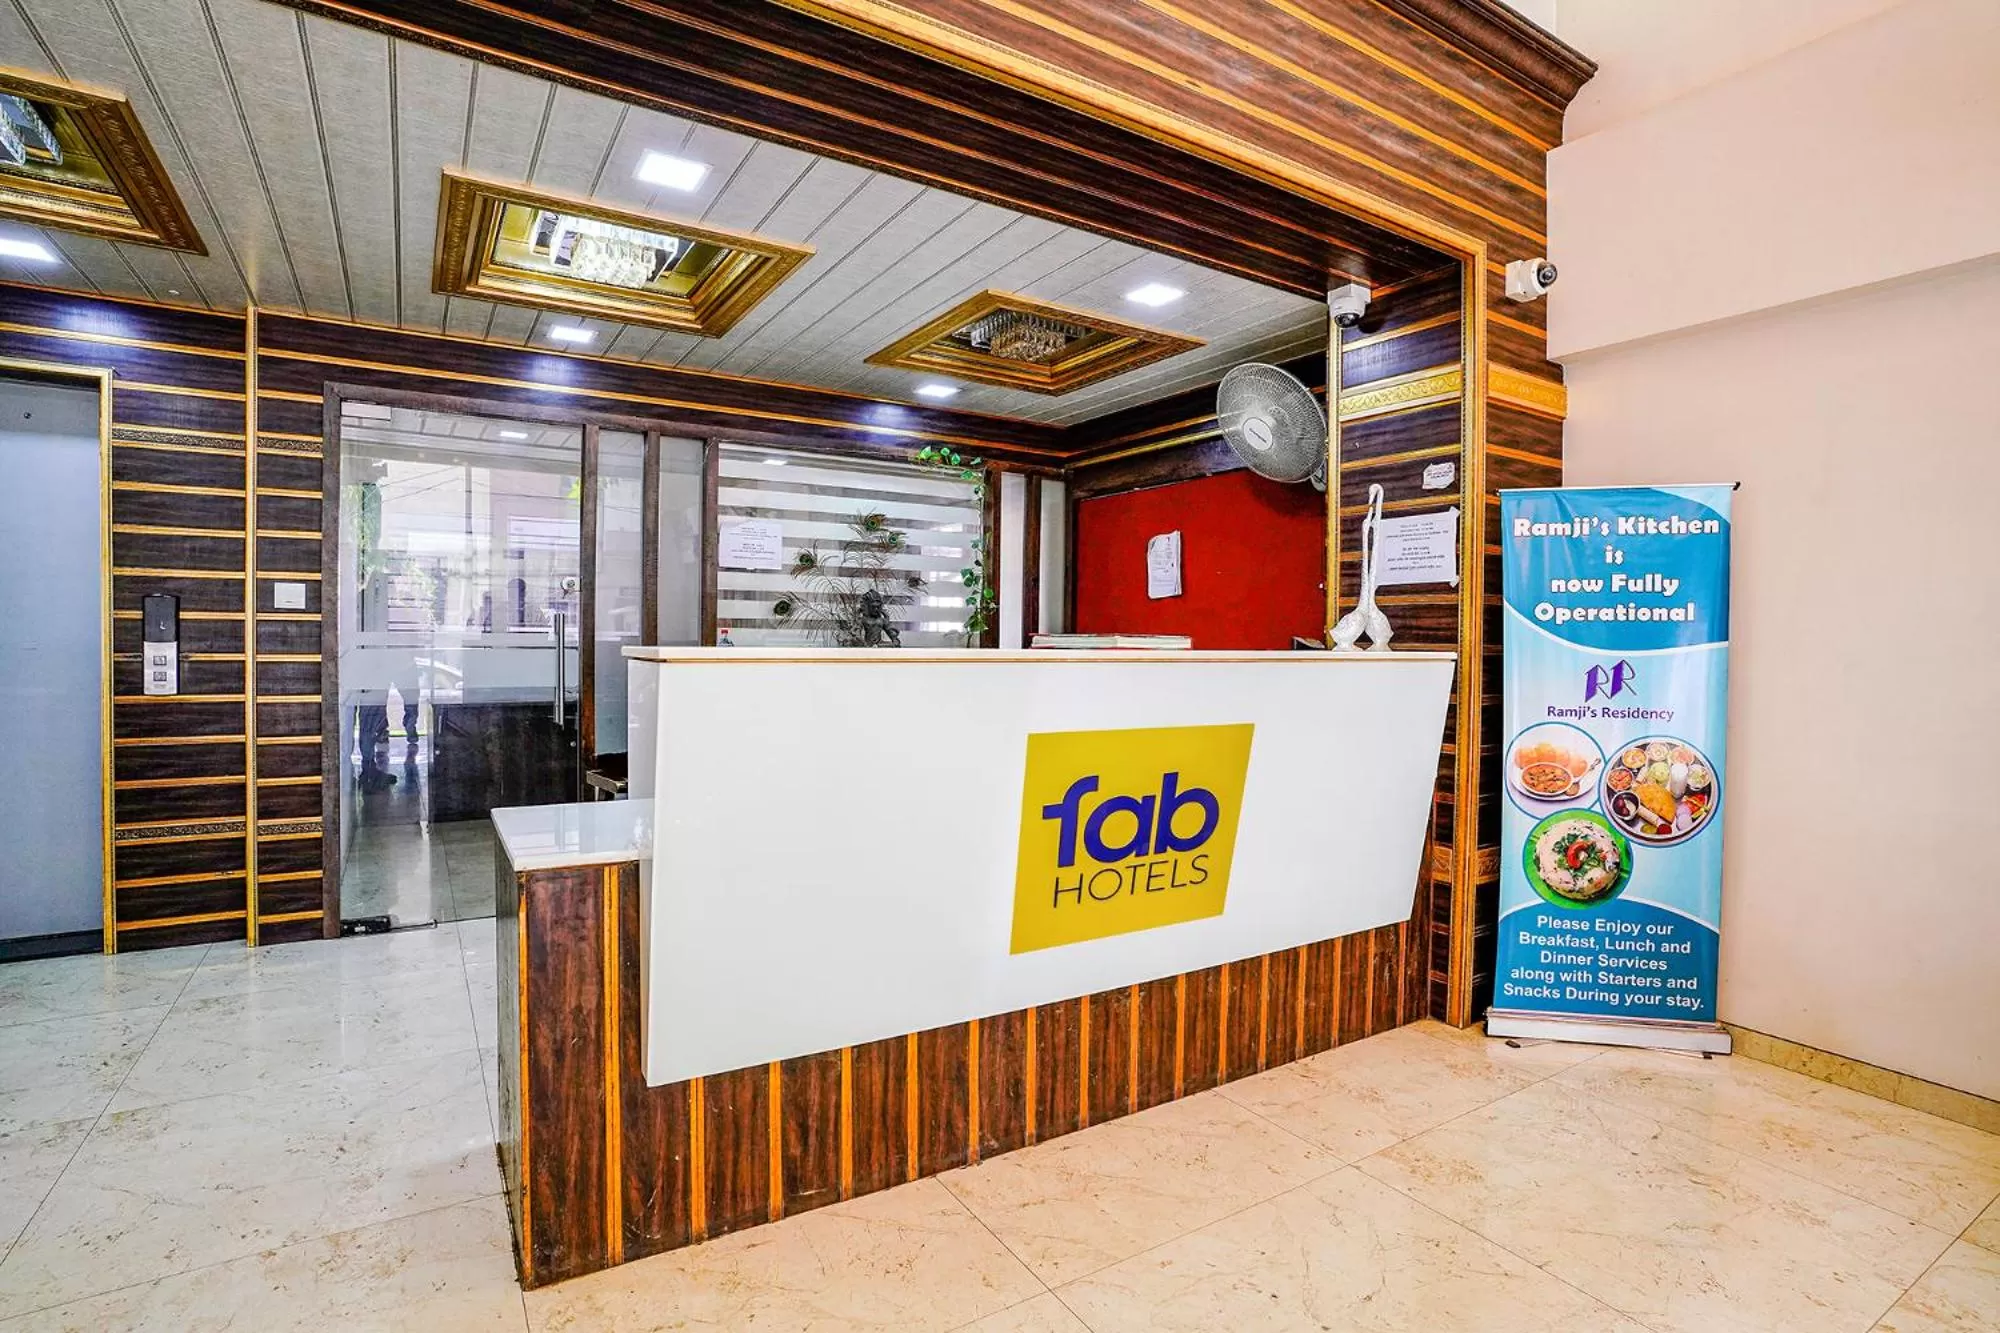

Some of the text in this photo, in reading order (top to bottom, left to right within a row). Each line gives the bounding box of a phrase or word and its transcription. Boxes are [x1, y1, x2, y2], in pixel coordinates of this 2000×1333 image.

[1513, 516, 1720, 538] Ramji's Kitchen
[1605, 546, 1624, 565] is
[1551, 575, 1679, 596] now Fully
[1534, 603, 1695, 624] Operational
[1547, 706, 1674, 722] Ramji's Residency
[1042, 772, 1219, 868] fab
[1053, 855, 1209, 908] HOTELS
[1537, 916, 1673, 935] Please Enjoy our
[1519, 932, 1691, 954] Breakfast, Lunch and
[1540, 951, 1668, 971] Dinner Services
[1511, 968, 1697, 990] along with Starters and
[1504, 984, 1704, 1009] Snacks During your stay.
